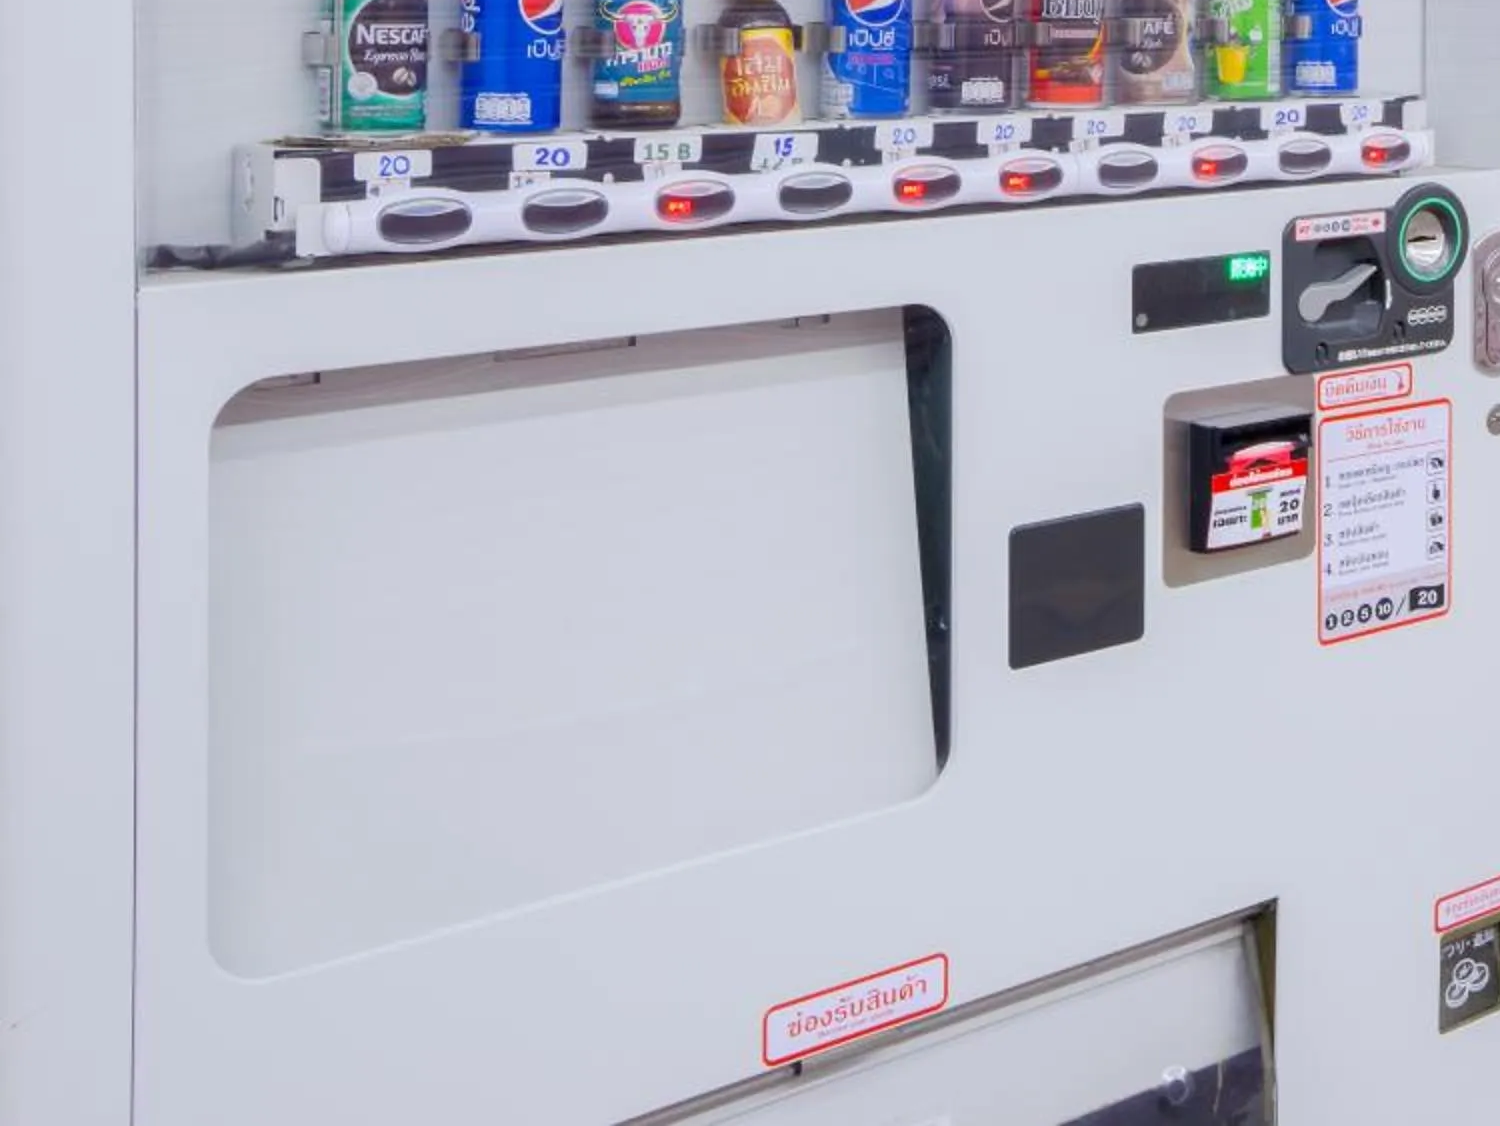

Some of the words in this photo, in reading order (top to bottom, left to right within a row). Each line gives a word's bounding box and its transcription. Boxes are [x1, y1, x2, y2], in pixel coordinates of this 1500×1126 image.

[1178, 116, 1197, 132] 20
[1275, 110, 1300, 125] 20
[892, 127, 916, 145] 20
[995, 125, 1015, 141] 20
[643, 142, 671, 161] 15
[677, 142, 692, 160] B
[773, 137, 795, 157] 15
[379, 155, 410, 177] 20
[535, 147, 571, 167] 20
[1280, 498, 1299, 513] 20
[1417, 590, 1438, 606] 20
[788, 974, 928, 1038] ช่องรับสินค้า
